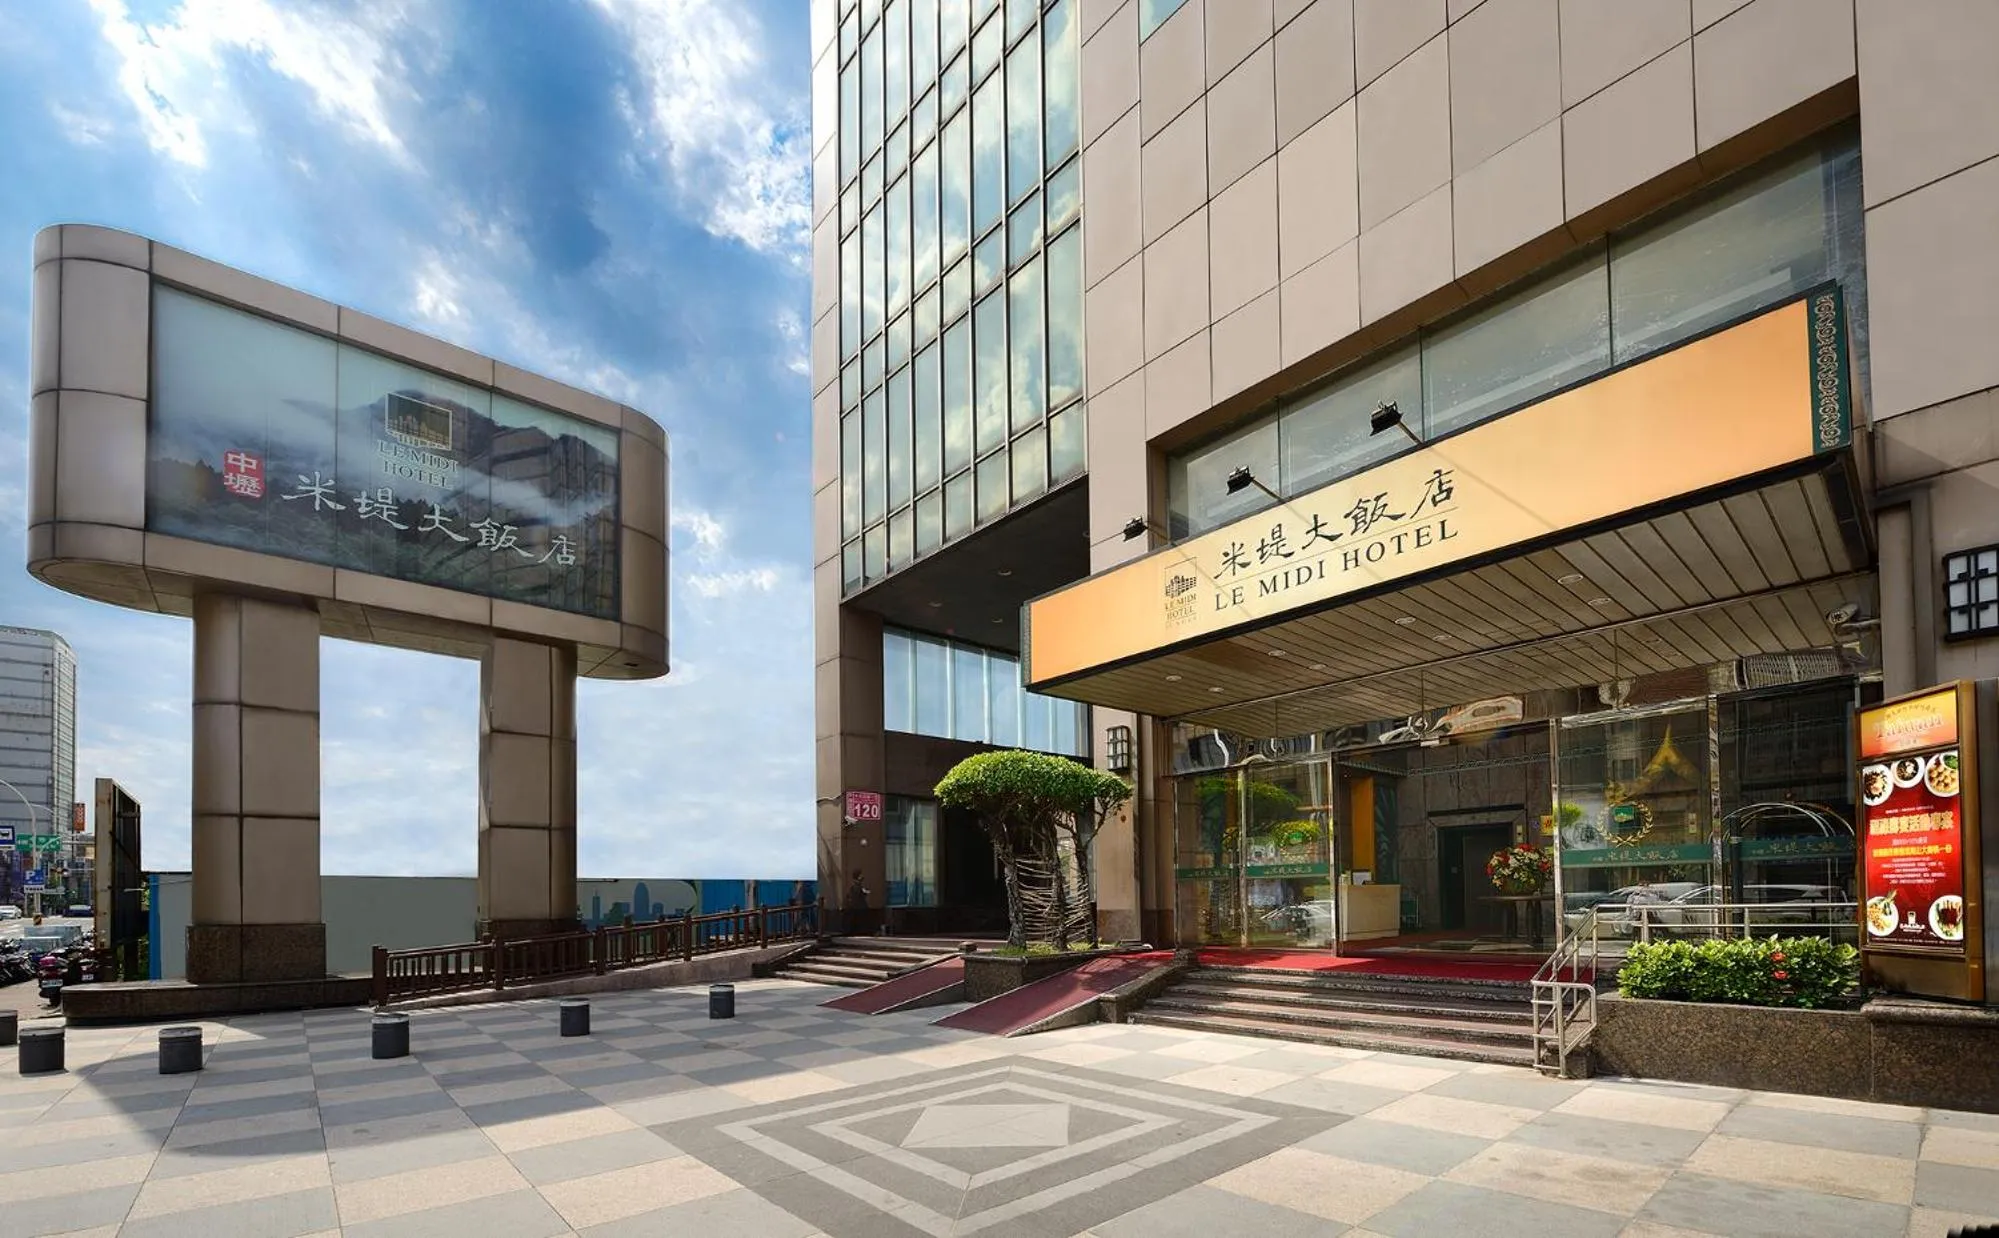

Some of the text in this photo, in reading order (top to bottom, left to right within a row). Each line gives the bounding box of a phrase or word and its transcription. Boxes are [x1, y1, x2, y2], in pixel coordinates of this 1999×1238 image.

[224, 452, 261, 498] 中壢
[377, 439, 459, 472] LE MIDI
[383, 459, 454, 490] HOTEL
[280, 470, 577, 567] 米堤大飯店
[1213, 468, 1456, 580] 米堤大飯店
[1215, 518, 1459, 611] LE MIDI HOTEL
[855, 803, 878, 818] 120
[25, 870, 36, 880] P
